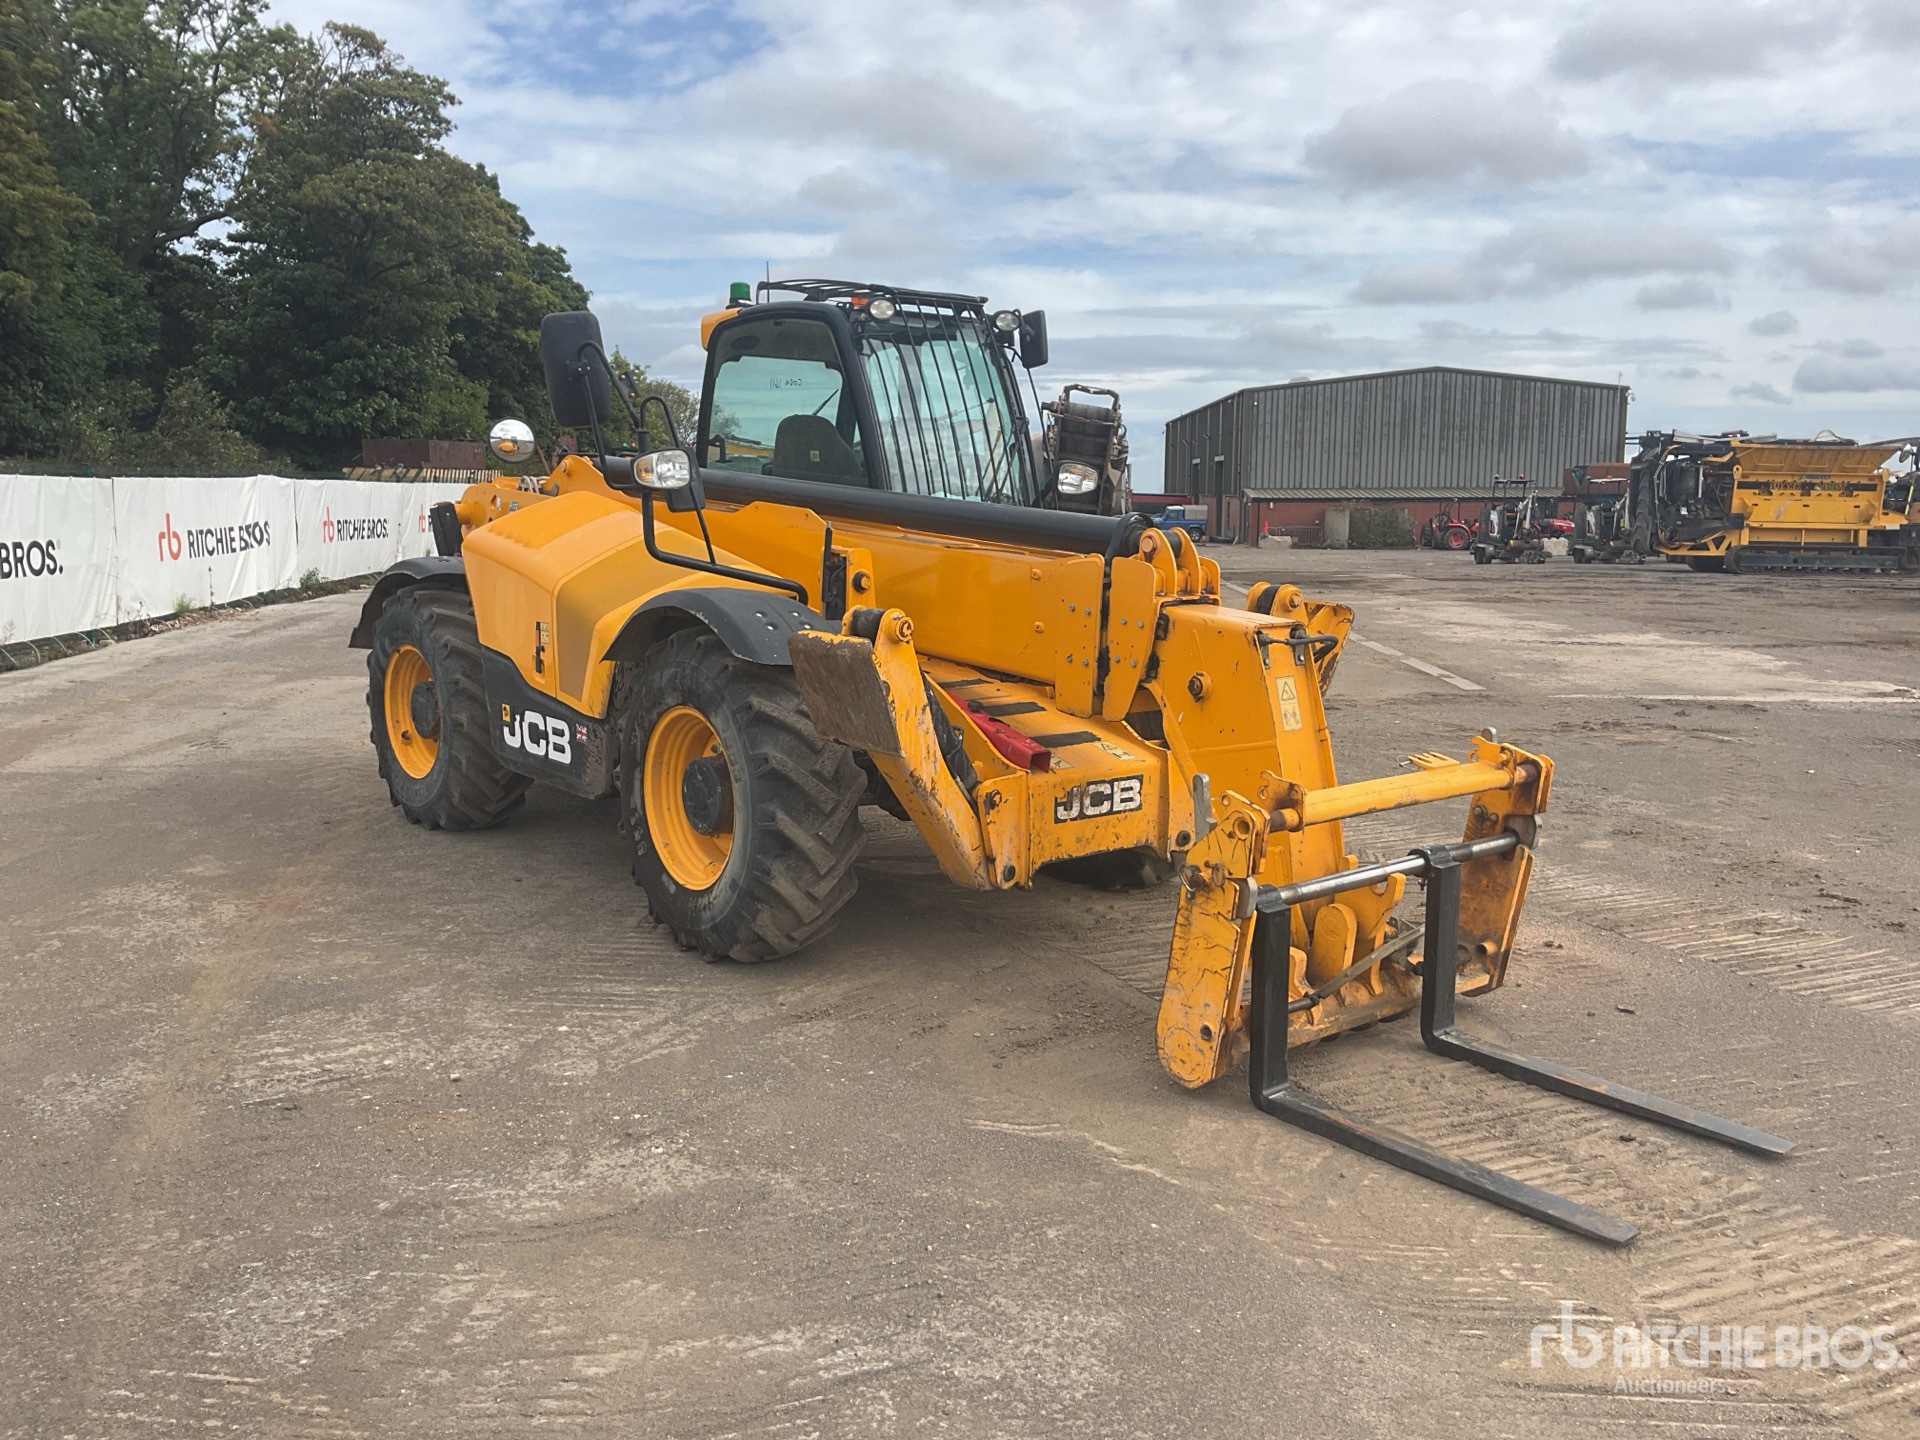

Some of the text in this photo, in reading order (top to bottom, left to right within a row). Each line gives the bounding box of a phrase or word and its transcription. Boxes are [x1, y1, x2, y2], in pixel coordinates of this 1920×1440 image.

[158, 512, 182, 562] rb
[186, 526, 237, 559] RITCHIE
[322, 506, 335, 543] rb
[336, 518, 366, 541] RITCHIE
[0, 539, 64, 579] BROS.
[503, 710, 572, 764] JCB
[1055, 778, 1141, 820] JCB
